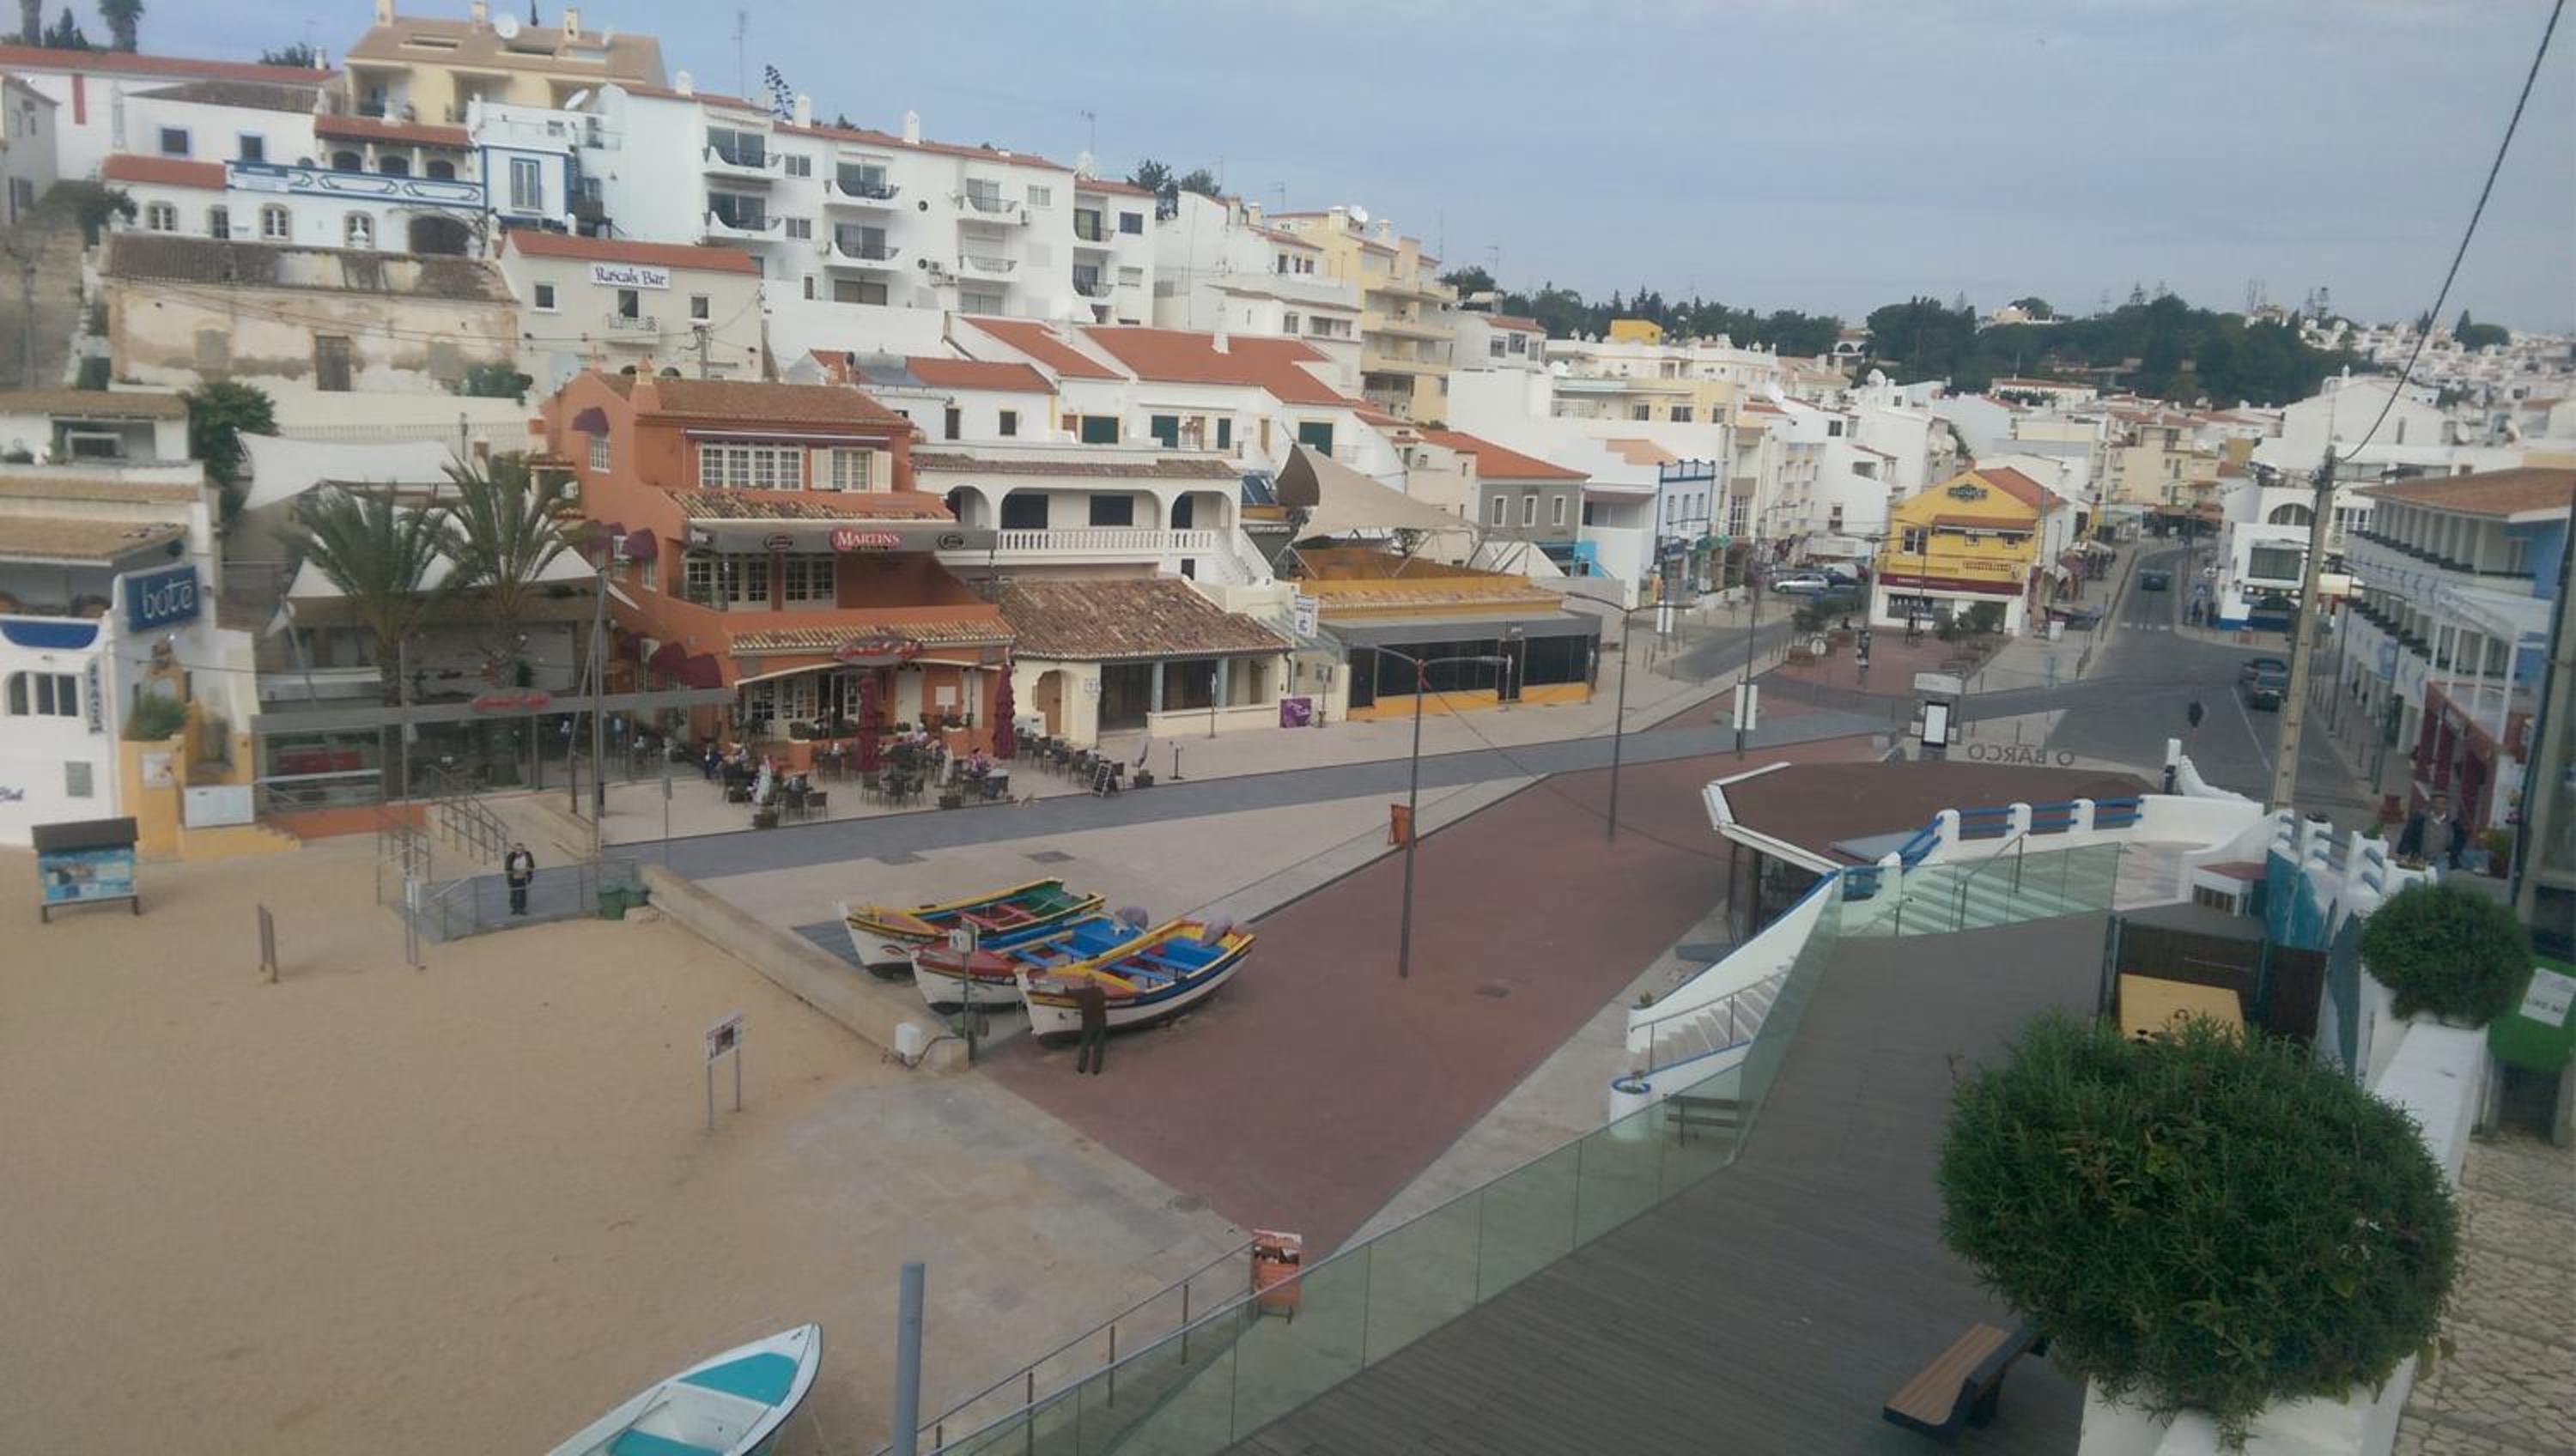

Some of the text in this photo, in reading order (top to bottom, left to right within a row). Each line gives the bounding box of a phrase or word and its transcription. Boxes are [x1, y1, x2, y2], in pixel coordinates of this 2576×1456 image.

[594, 266, 666, 286] Rascals Bar
[836, 531, 901, 548] MARTINS
